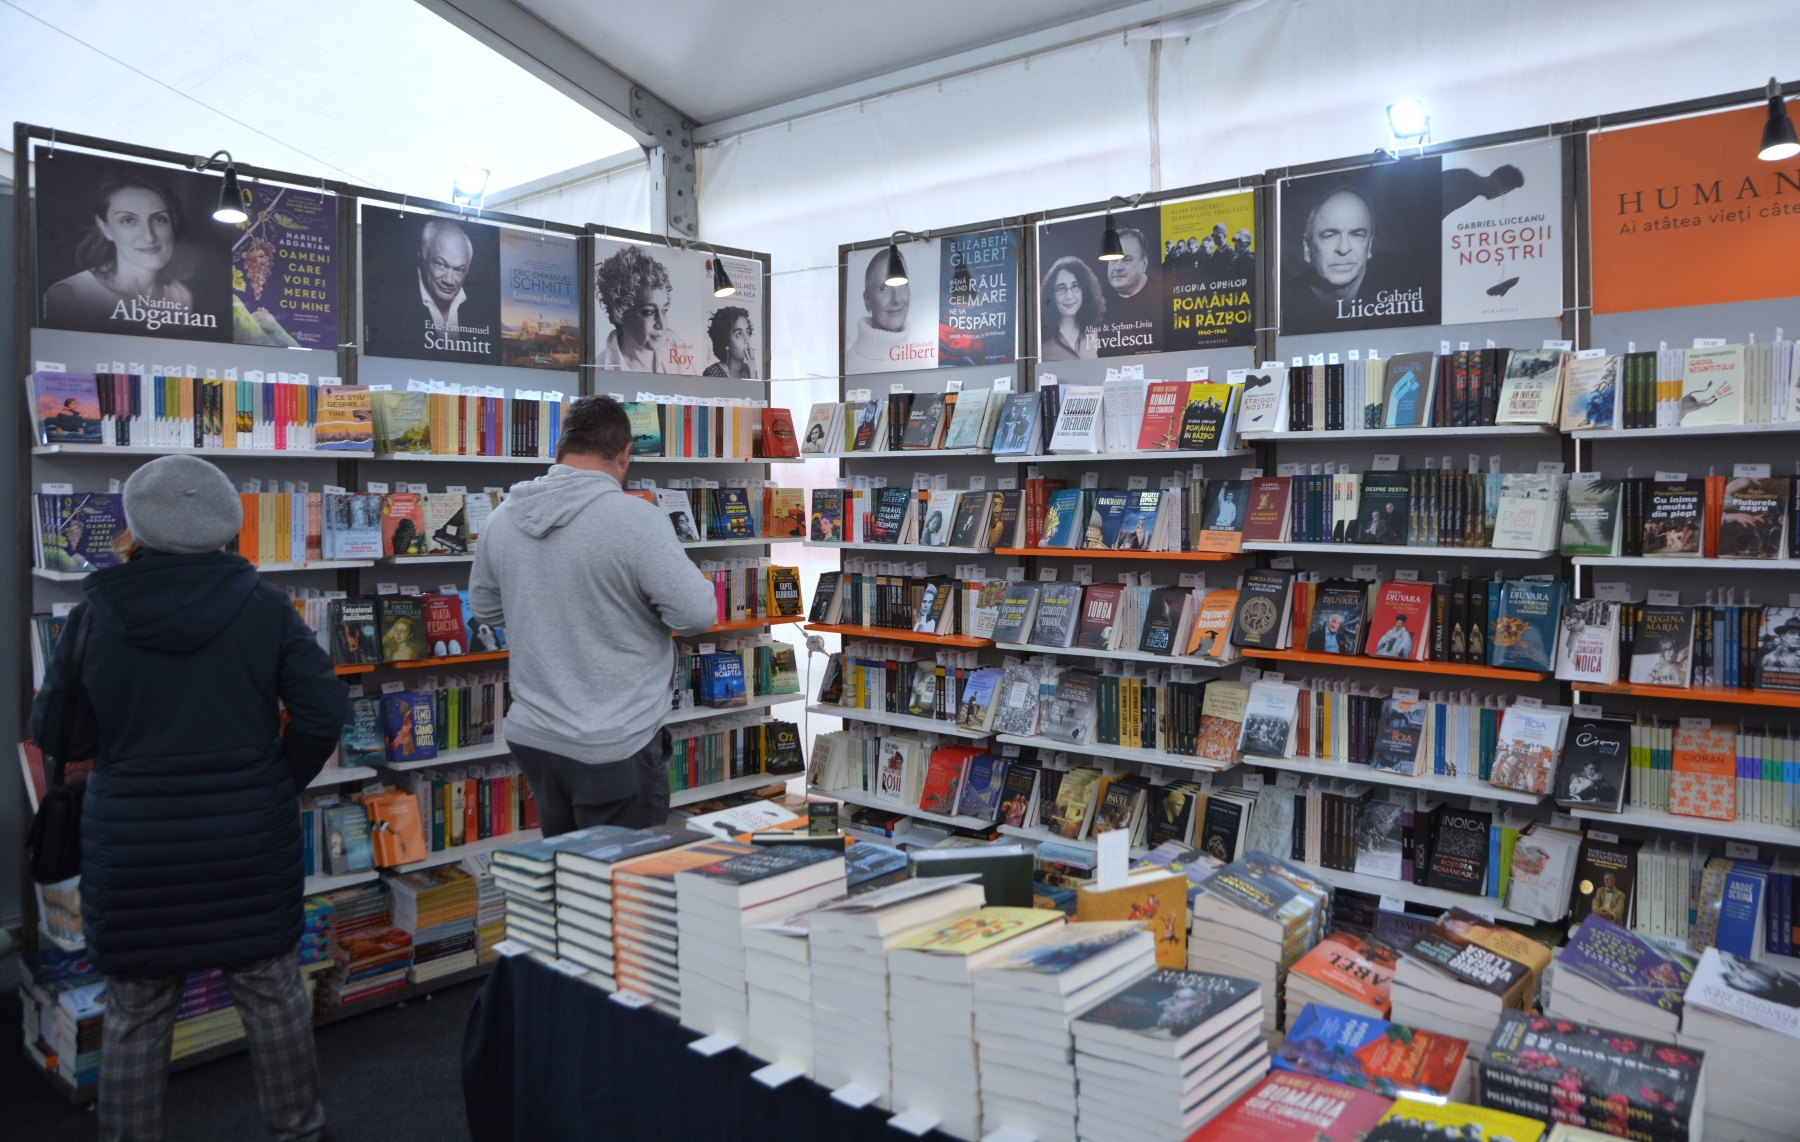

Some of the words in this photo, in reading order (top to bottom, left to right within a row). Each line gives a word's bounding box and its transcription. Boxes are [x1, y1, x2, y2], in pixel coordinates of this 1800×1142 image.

[1171, 207, 1188, 215] ALINA
[1190, 202, 1225, 212] PAVELESCU
[1213, 205, 1250, 215] PAVELESCU
[1457, 219, 1497, 231] GABRIEL
[1499, 214, 1546, 227] LIICEANU
[1620, 221, 1637, 235] Ai
[1643, 216, 1701, 232] atâtea
[1709, 206, 1750, 224] vieți
[279, 239, 331, 251] ABGARIAN
[286, 232, 324, 243] NARINE
[951, 235, 1008, 252] ELIZABETH
[1451, 225, 1552, 250] STRIGOII
[279, 249, 331, 264] OAMENI
[950, 247, 1007, 267] GILBERT
[1459, 243, 1543, 266] NOȘTRI
[288, 263, 322, 275] CARE
[513, 268, 572, 284] ERIC-EMMANUEL
[284, 275, 310, 286] VOR
[315, 279, 326, 288] FI
[513, 276, 572, 296] SCHMITT
[950, 285, 967, 293] CÂND
[1173, 284, 1207, 294] ISTORIA
[1210, 278, 1248, 290] ORBILOR
[284, 288, 327, 300] MEREU
[513, 290, 541, 302] Lumina
[543, 294, 570, 305] fericirii
[949, 297, 967, 306] CEL
[1173, 291, 1250, 312] ROMÂNIA
[1376, 287, 1422, 303] Gabriel
[137, 294, 182, 311] Narine
[279, 300, 297, 309] CU
[301, 303, 331, 313] MINE
[1336, 297, 1425, 319] Liiceanu
[110, 299, 218, 330] Abgarian
[949, 312, 1006, 330] DESPĂRȚI
[1174, 313, 1190, 330] ÎN
[1195, 309, 1252, 328] RĂZBOI
[424, 319, 490, 335] Eric-Emmanuel
[1085, 325, 1102, 333] Alina
[1111, 320, 1153, 333] Șerban-Liviu
[424, 331, 491, 354] Schmitt
[912, 340, 934, 349] Elizabeth
[1085, 330, 1153, 350] Pavelescu
[669, 349, 694, 370] Roy
[889, 344, 935, 361] Gilbert
[1394, 364, 1424, 374] Liiceanu
[1689, 359, 1714, 367] GHIDUL
[1150, 393, 1177, 406] ROMÂNIA
[1244, 397, 1277, 405] STRIGOII
[1245, 402, 1273, 411] NOȘTRI
[1502, 510, 1536, 528] Pleșu
[1651, 510, 1667, 518] din
[1670, 509, 1697, 519] piept
[1322, 596, 1359, 605] DJUVARA
[1386, 593, 1421, 603] DJUVARA
[1510, 591, 1549, 601] DJUVARA
[1088, 601, 1112, 619] IORGA
[1645, 622, 1680, 632] MARIA
[1647, 615, 1685, 624] REGINA
[1575, 654, 1602, 673] NOICA
[715, 669, 742, 678] NOAPTEA
[1266, 695, 1285, 705] BOIA
[1524, 720, 1546, 730] BOIA
[778, 731, 795, 742] Oz
[1391, 732, 1412, 742] BOIA
[1682, 753, 1725, 765] CIORAN
[1106, 795, 1128, 807] PAVEL
[1587, 852, 1628, 865] PATAPIEVICI
[1588, 848, 1628, 859] HORIA-ROMAN
[1433, 864, 1480, 880] ROMÂNEASCĂ
[1441, 859, 1473, 871] ROSTIREA
[1730, 881, 1753, 893] ANDRÉ
[1728, 890, 1753, 903] SCRIMA
[1465, 944, 1512, 969] LLOSA
[1329, 951, 1392, 986] ABEL
[1449, 958, 1496, 985] MARIO
[1459, 950, 1513, 982] VARGAS
[1486, 1068, 1549, 1093] DESPĂRȚIM
[1550, 1086, 1567, 1099] NE
[1568, 1091, 1586, 1106] NU
[1258, 1083, 1347, 1118] ROMÂNIA
[1589, 1096, 1627, 1114] KANG
[1245, 1097, 1273, 1115] SUB
[1270, 1102, 1335, 1131] COMUNISM
[1550, 1107, 1567, 1120] NE
[1568, 1111, 1586, 1126] NU
[1627, 1107, 1653, 1122] HAN
